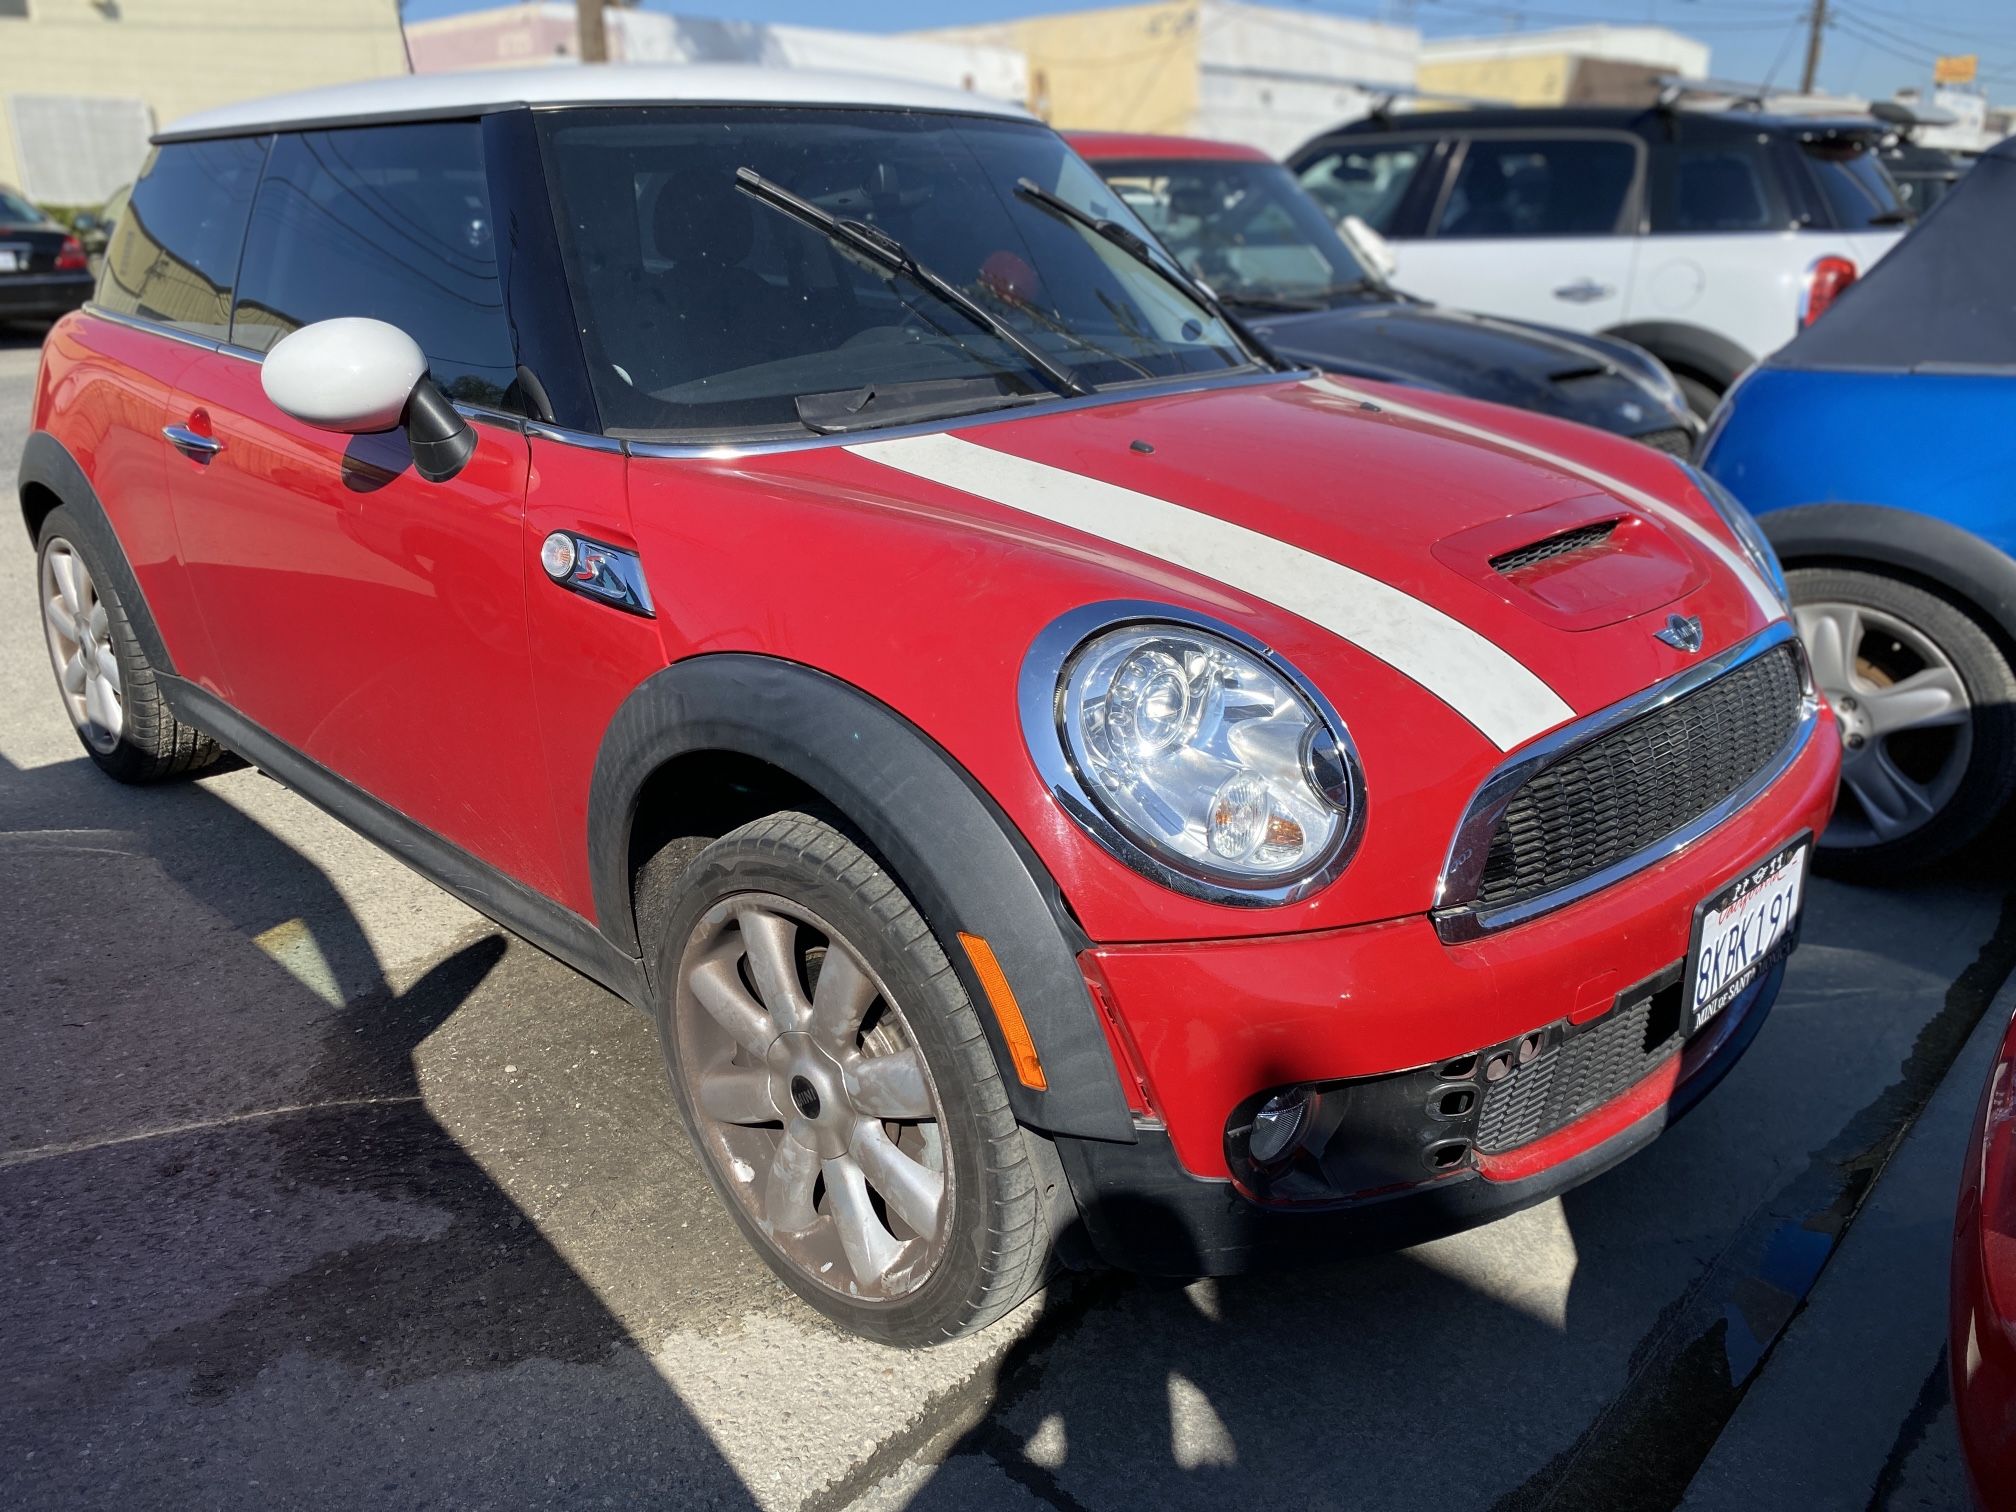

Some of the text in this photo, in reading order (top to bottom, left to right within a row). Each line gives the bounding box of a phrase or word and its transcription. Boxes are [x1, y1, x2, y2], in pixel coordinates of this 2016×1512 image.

[1696, 882, 1794, 1006] 8KBK191
[1693, 997, 1719, 1032] MINI
[1718, 991, 1730, 1009] OF
[794, 1088, 816, 1110] MINI
